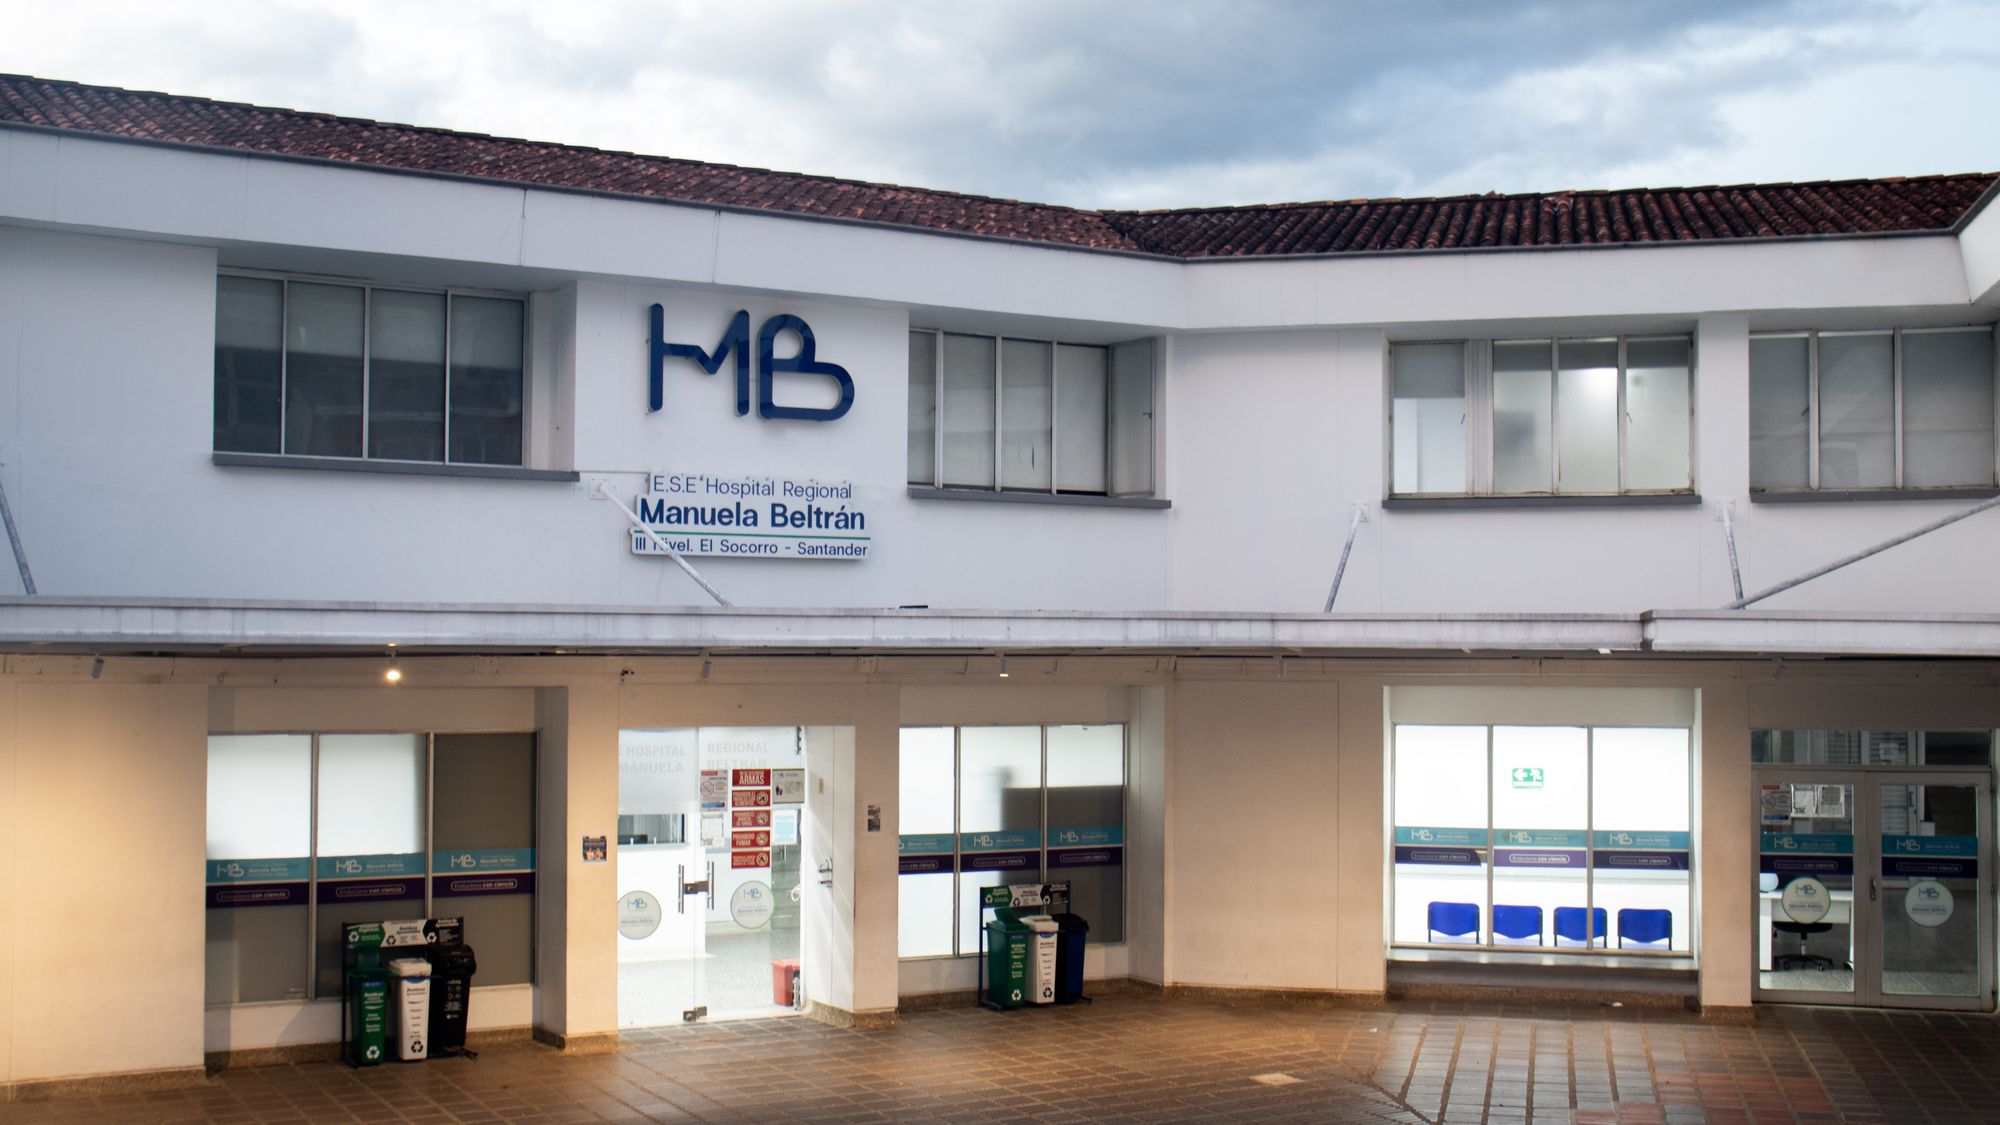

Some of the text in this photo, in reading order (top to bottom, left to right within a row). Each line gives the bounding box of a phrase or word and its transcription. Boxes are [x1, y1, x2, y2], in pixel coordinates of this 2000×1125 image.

[654, 475, 852, 503] E.S.E Hospital Regional
[640, 498, 865, 530] Manuela Beltrán
[635, 537, 647, 551] III
[700, 539, 713, 553] El
[720, 540, 778, 555] Socorro
[798, 542, 868, 557] Santander
[626, 744, 687, 757] HOSPITAL
[707, 742, 769, 753] REGIONAL
[739, 774, 765, 785] ARMAS
